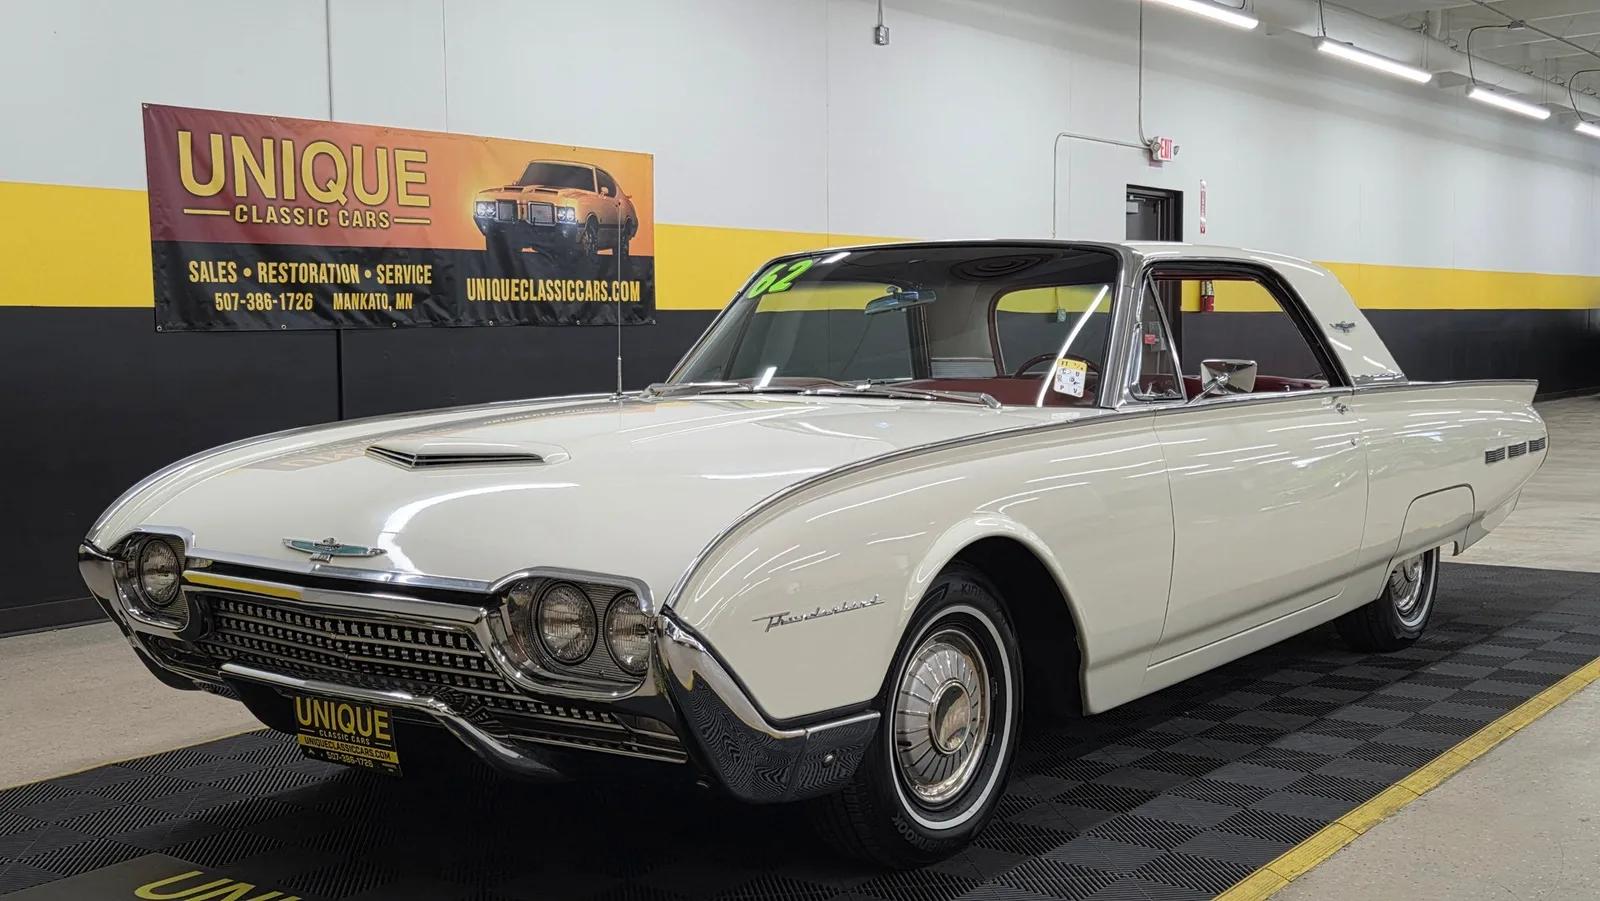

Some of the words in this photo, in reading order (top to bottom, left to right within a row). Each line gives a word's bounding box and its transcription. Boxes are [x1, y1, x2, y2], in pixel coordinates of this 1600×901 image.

[1160, 138, 1173, 159] EXIT
[177, 130, 431, 208] UNIQUE
[233, 204, 330, 226] CLASSIC
[338, 209, 391, 229] CARS
[188, 260, 238, 284] SALES
[257, 262, 360, 285] RESTORATION
[376, 264, 433, 285] SERVICE
[746, 259, 814, 299] 62
[214, 292, 313, 312] 507-386-1726
[333, 292, 392, 311] MANKATO,
[395, 292, 414, 310] MN
[466, 278, 641, 302] UNIQUECLASSICCARS.COM
[752, 593, 885, 633] Thunderbird
[295, 696, 391, 741] UNIQUE
[318, 729, 349, 742] CLASSIC
[351, 736, 371, 746] CARS
